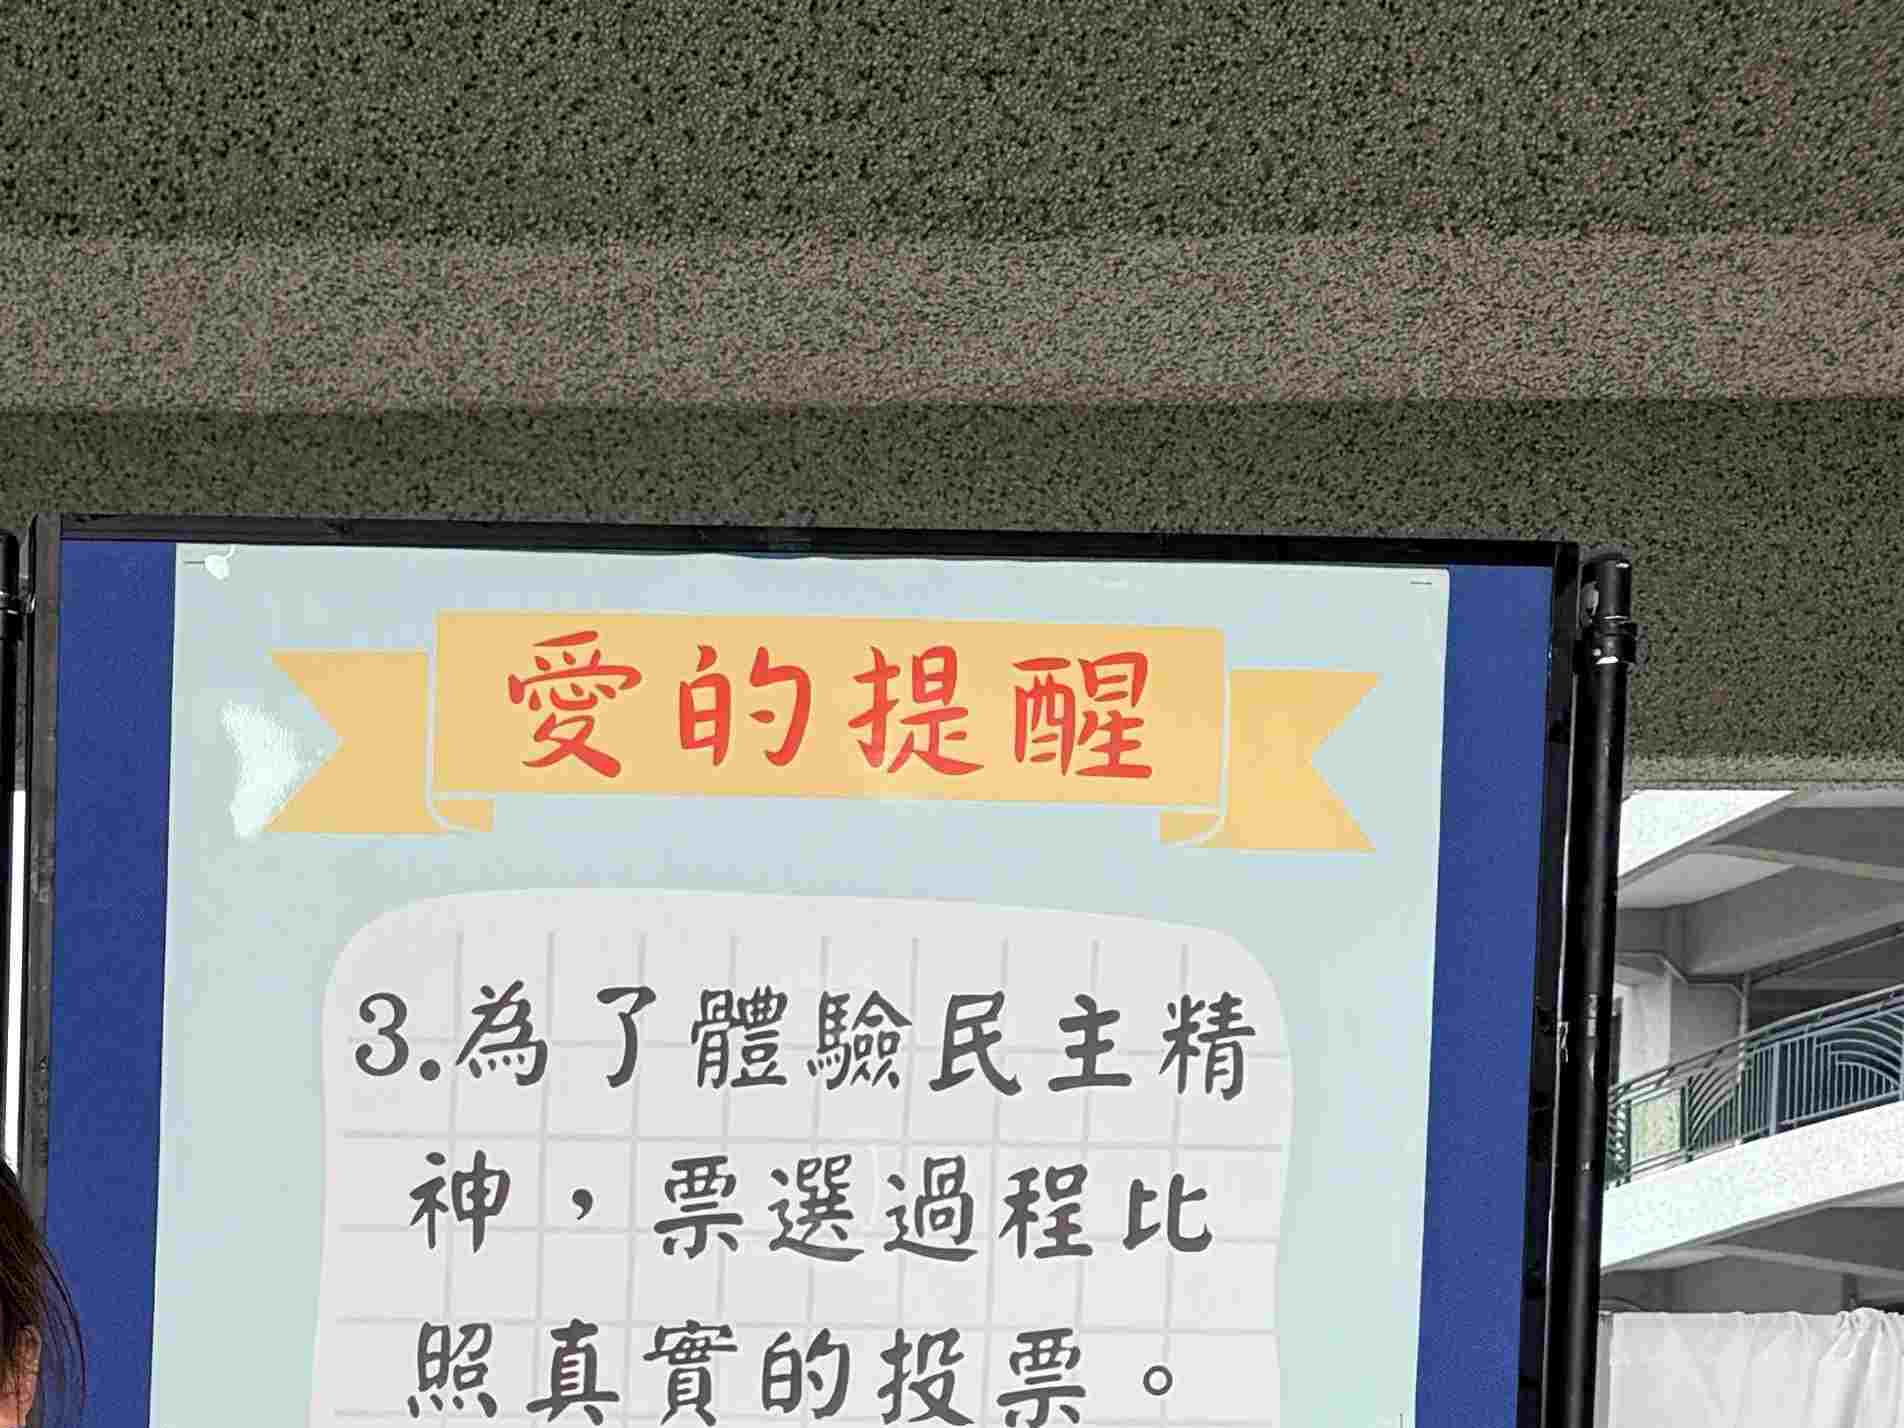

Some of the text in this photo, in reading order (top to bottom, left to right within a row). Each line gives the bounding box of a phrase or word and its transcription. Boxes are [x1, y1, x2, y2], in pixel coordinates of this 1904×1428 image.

[506, 629, 1152, 782] 愛的提醒
[354, 979, 1257, 1103] 3.為了體驗民主精
[408, 1150, 1216, 1265] 神，票選過程比
